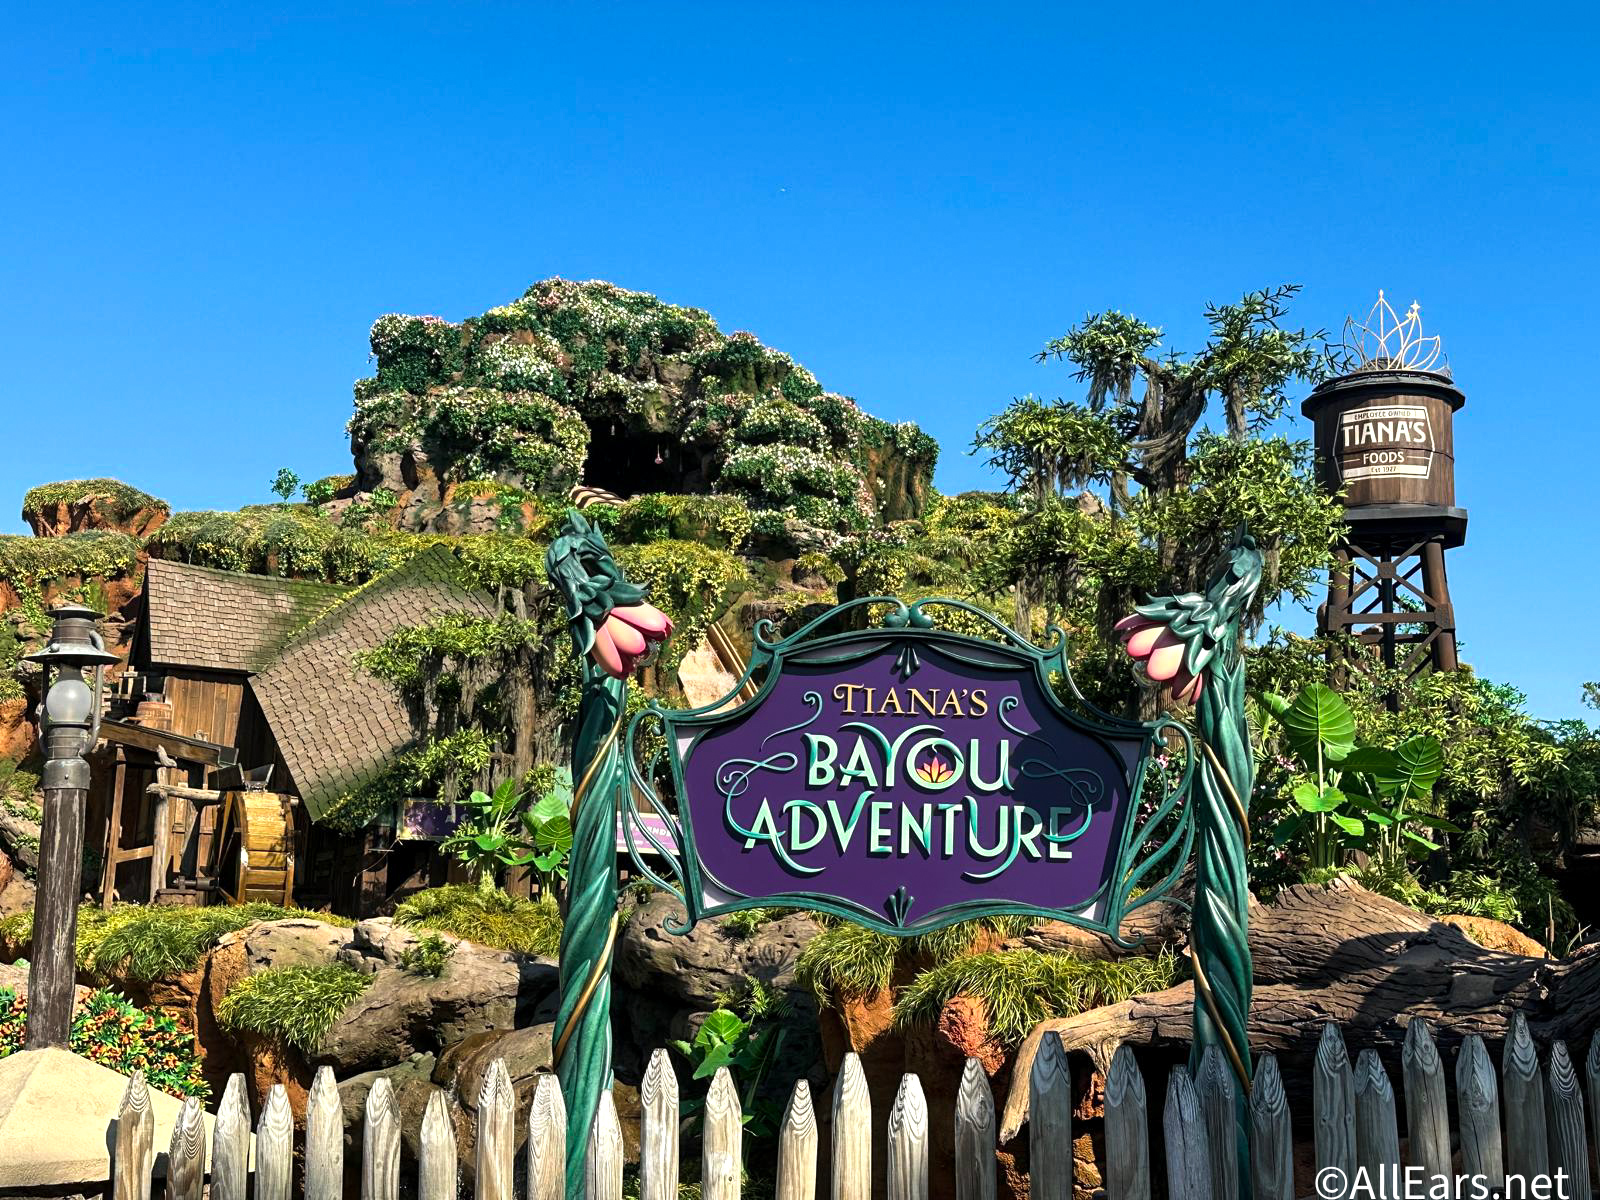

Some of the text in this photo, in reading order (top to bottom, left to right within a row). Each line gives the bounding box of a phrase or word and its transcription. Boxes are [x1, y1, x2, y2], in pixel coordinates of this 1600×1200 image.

[1342, 421, 1426, 446] TIANA'S
[1363, 452, 1404, 464] FOODS
[833, 683, 989, 717] TIANA'S
[804, 721, 1015, 791] BAYOU
[743, 790, 1074, 879] ADVENTURE
